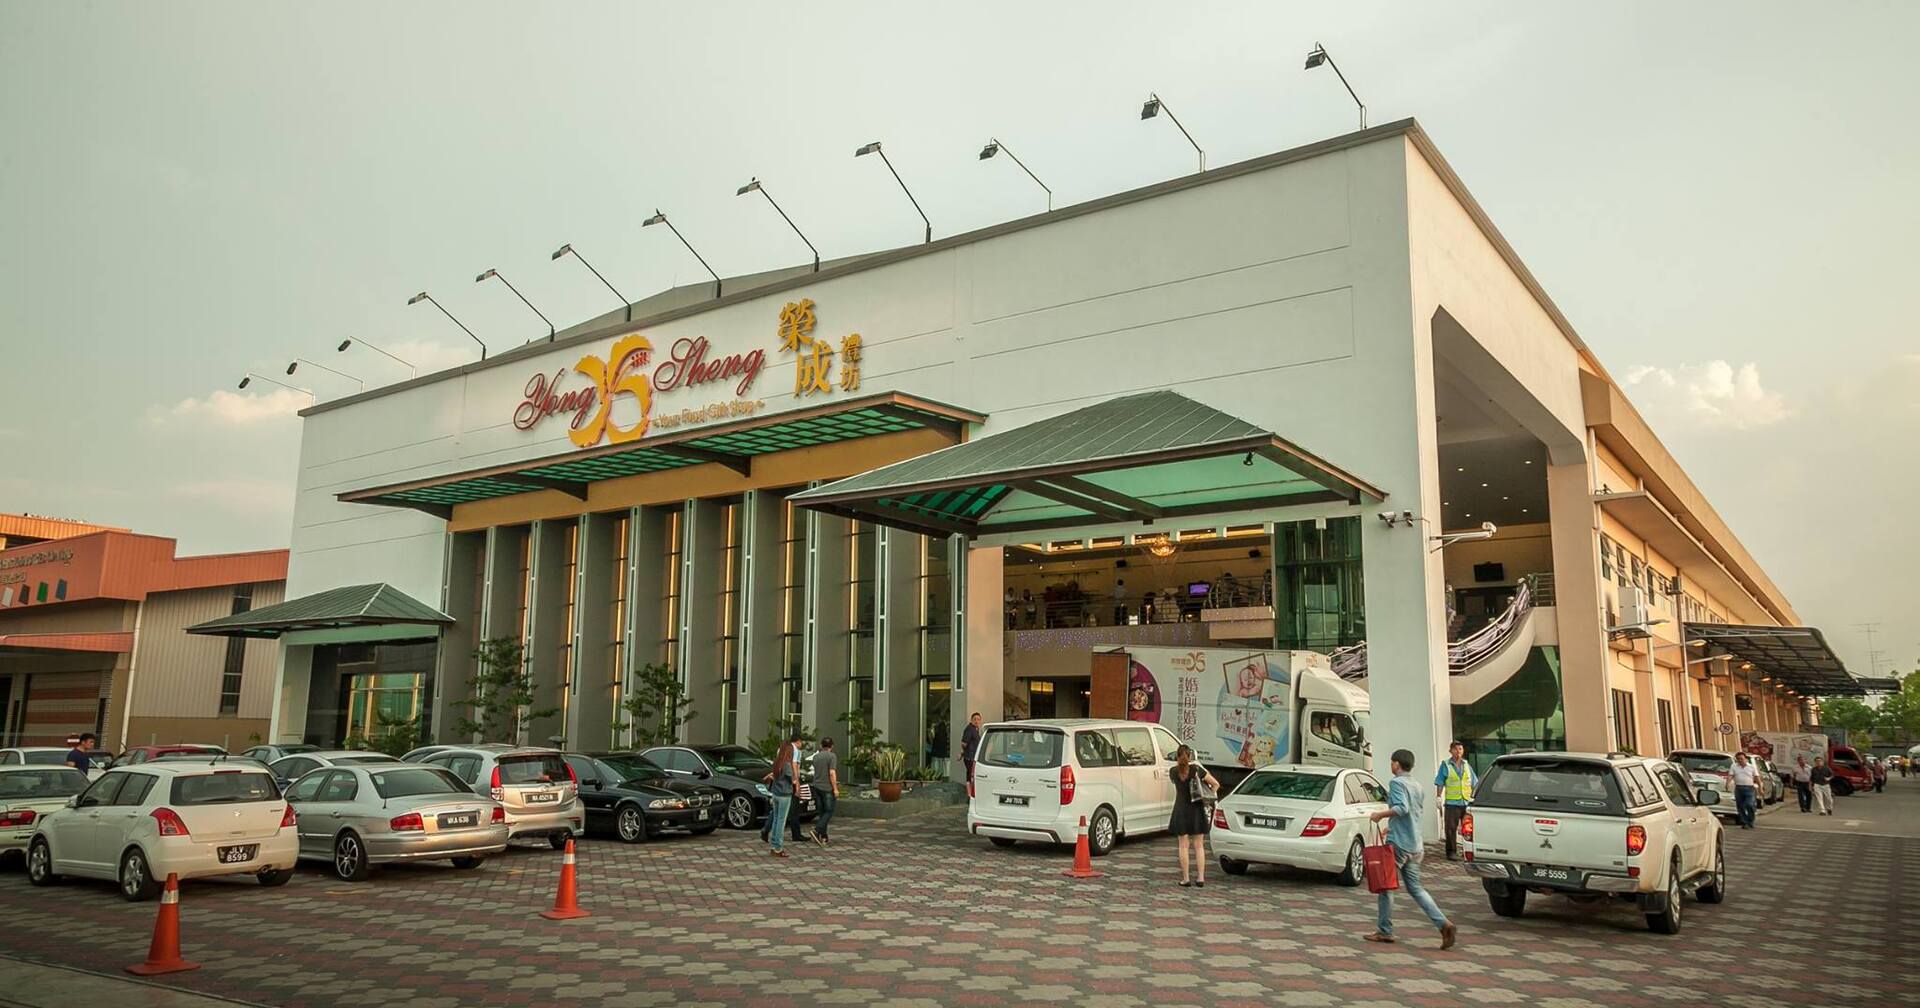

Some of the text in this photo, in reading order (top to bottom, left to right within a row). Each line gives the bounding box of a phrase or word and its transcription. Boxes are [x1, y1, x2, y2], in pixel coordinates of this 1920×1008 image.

[513, 335, 765, 430] Yong Sheng
[682, 404, 706, 423] Food
[729, 399, 755, 417] Shop
[1182, 676, 1199, 741] 婚前婚後
[226, 852, 248, 862] 8599
[229, 846, 244, 854] JLV
[1549, 870, 1568, 880] 5555
